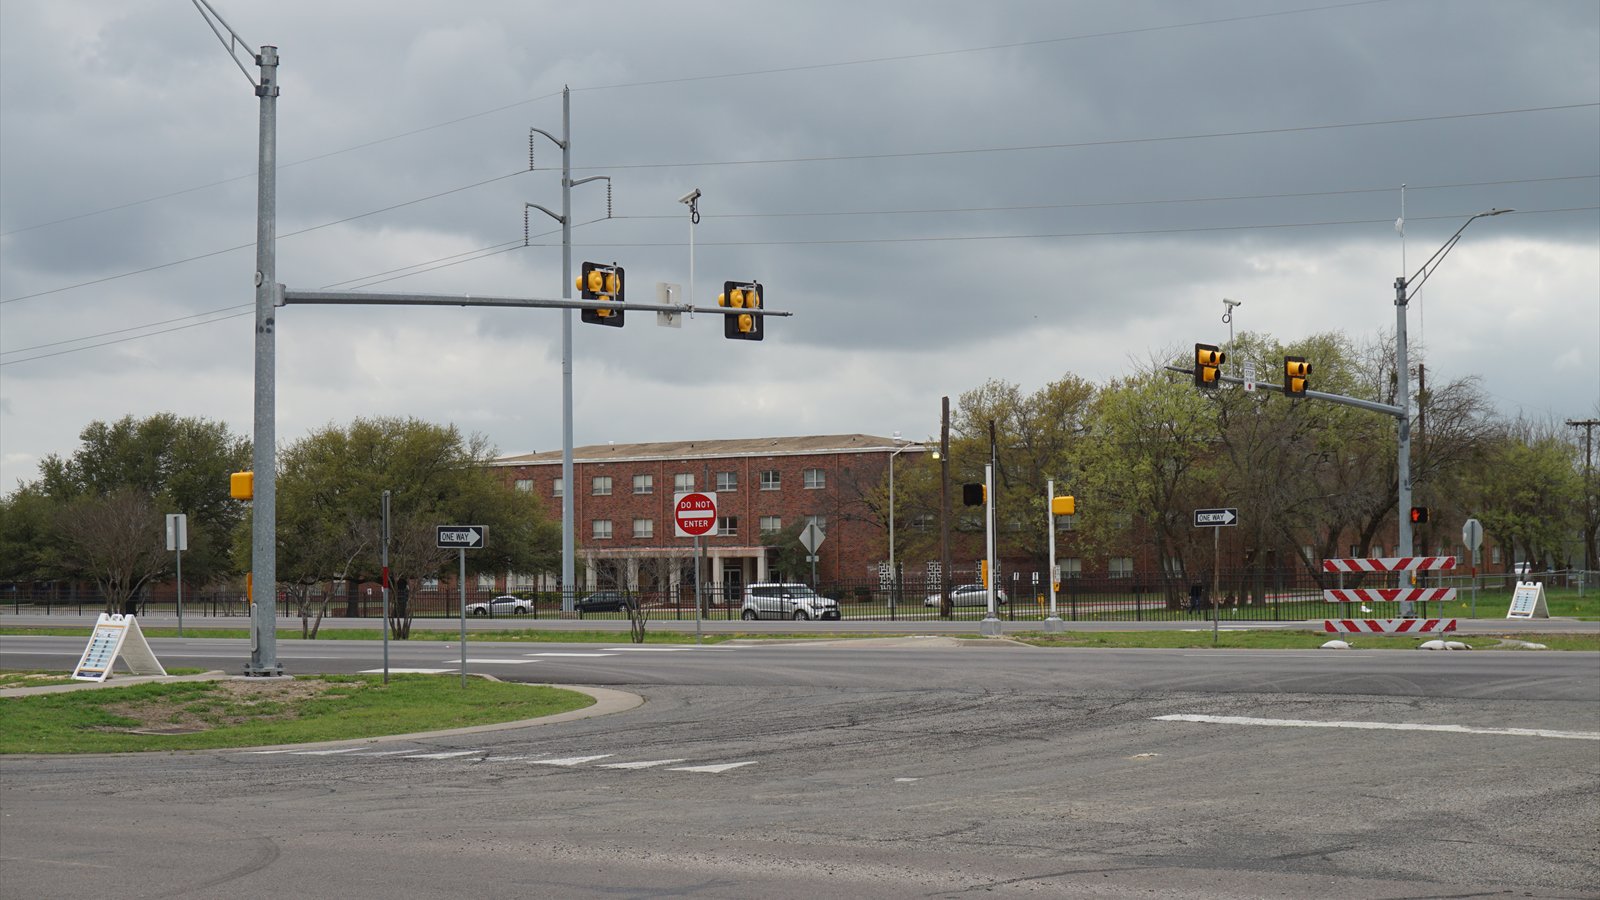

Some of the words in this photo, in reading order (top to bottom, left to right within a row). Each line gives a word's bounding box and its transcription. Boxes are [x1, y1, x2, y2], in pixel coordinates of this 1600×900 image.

[680, 501, 692, 509] DO
[695, 500, 711, 508] NOT
[1199, 514, 1211, 522] ONE
[684, 520, 709, 528] ENTER
[441, 532, 455, 541] ONE
[455, 532, 469, 541] WAY
